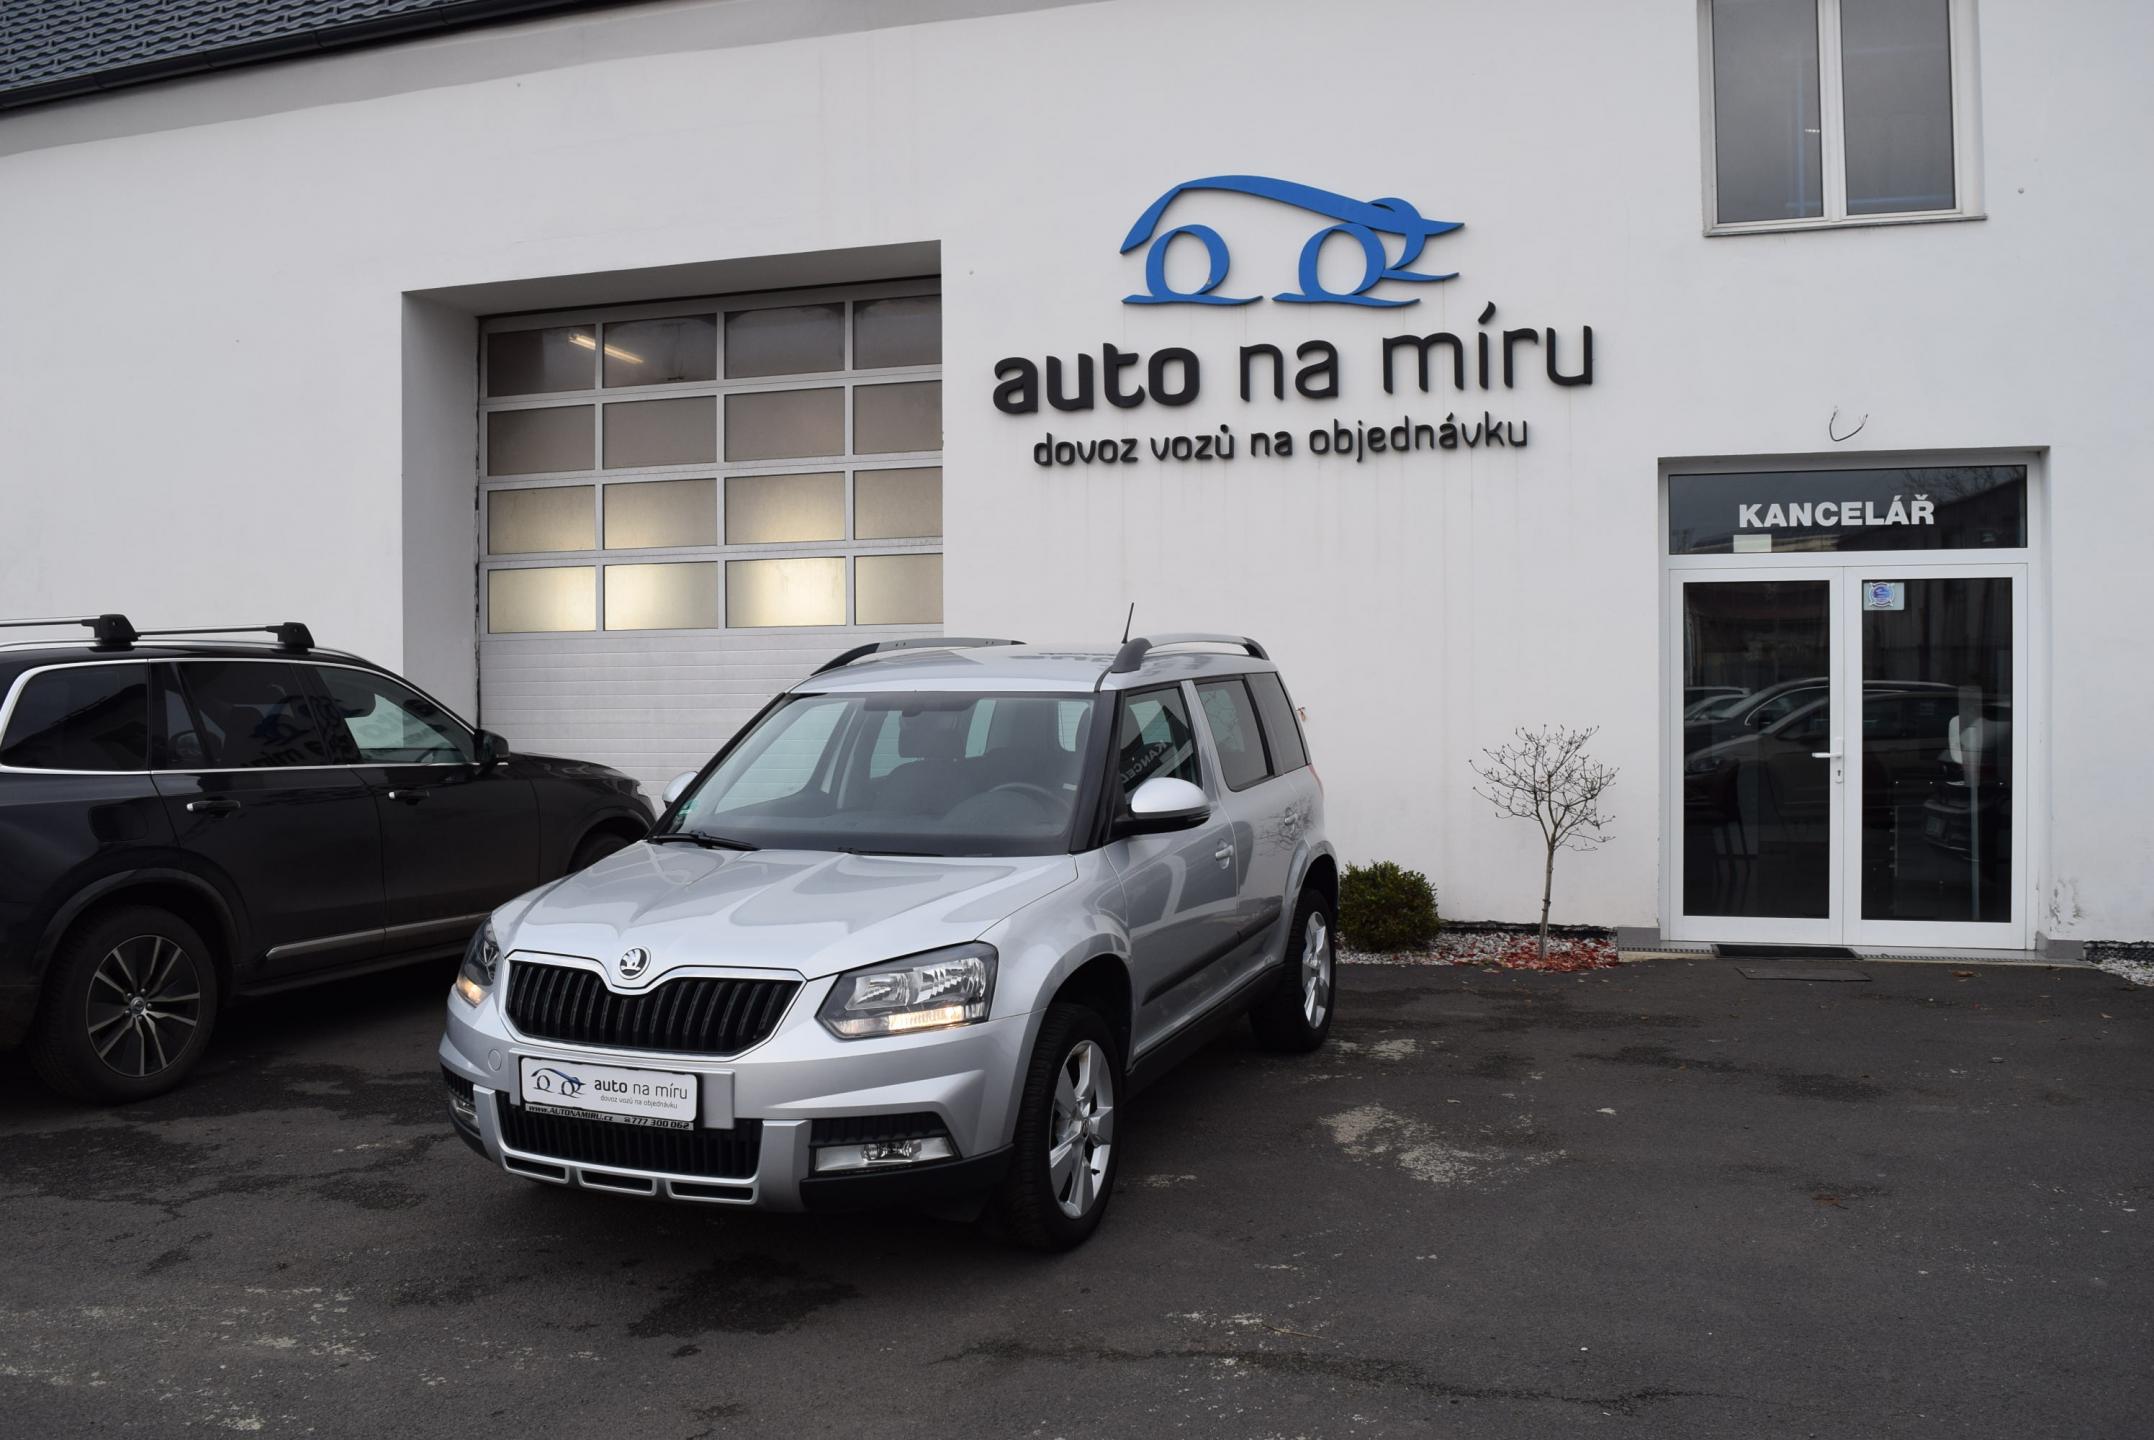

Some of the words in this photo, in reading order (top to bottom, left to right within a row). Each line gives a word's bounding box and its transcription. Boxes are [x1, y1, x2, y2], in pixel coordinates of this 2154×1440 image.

[993, 342, 1200, 414] auto
[1240, 339, 1339, 402] na
[1383, 301, 1594, 394] míru
[1033, 432, 1138, 466] dovoz
[1151, 424, 1235, 462] vozů
[1251, 429, 1293, 458] na
[1309, 411, 1529, 463] objednávku
[1738, 494, 1935, 528] KANCELÁŘ
[594, 1079, 628, 1094] auto
[633, 1083, 650, 1096] na
[655, 1082, 688, 1100] míru
[600, 1095, 618, 1103] dovoz
